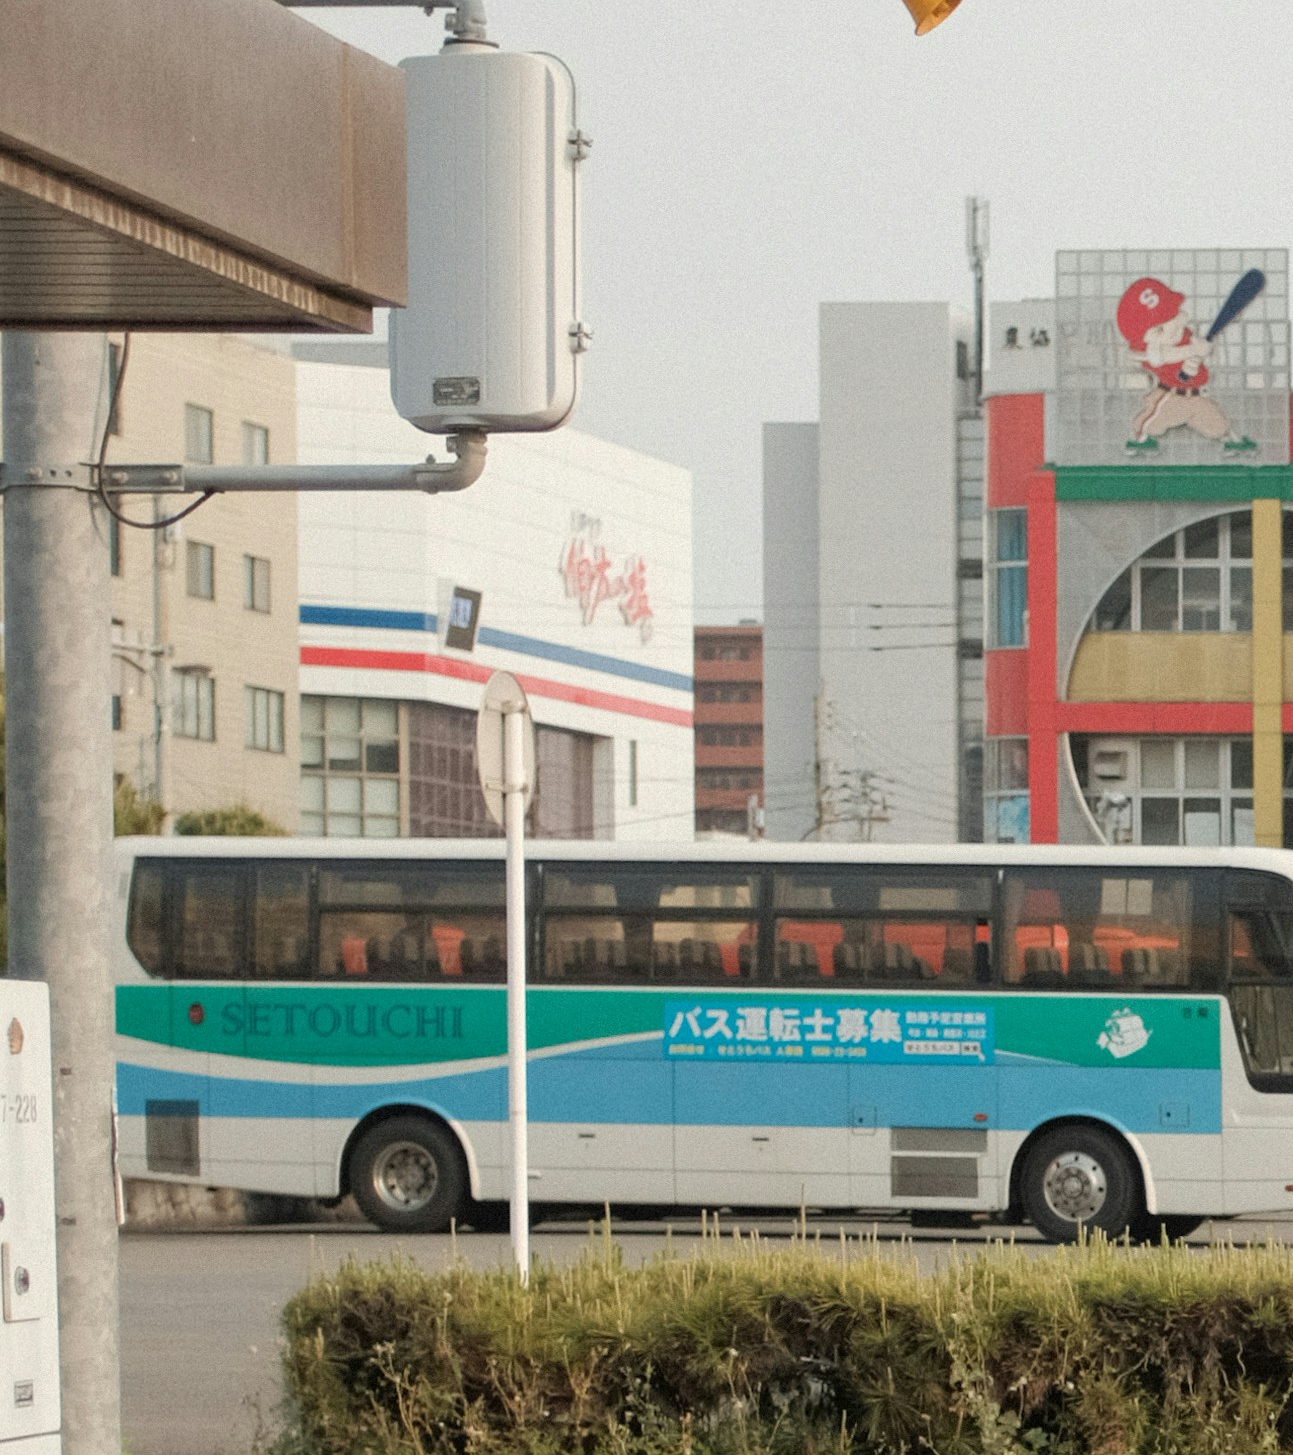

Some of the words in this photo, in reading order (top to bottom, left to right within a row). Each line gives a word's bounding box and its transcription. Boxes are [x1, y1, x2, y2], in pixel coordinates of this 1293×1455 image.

[221, 1002, 464, 1039] SETOUCHI
[668, 1006, 901, 1043] バス運転士募集
